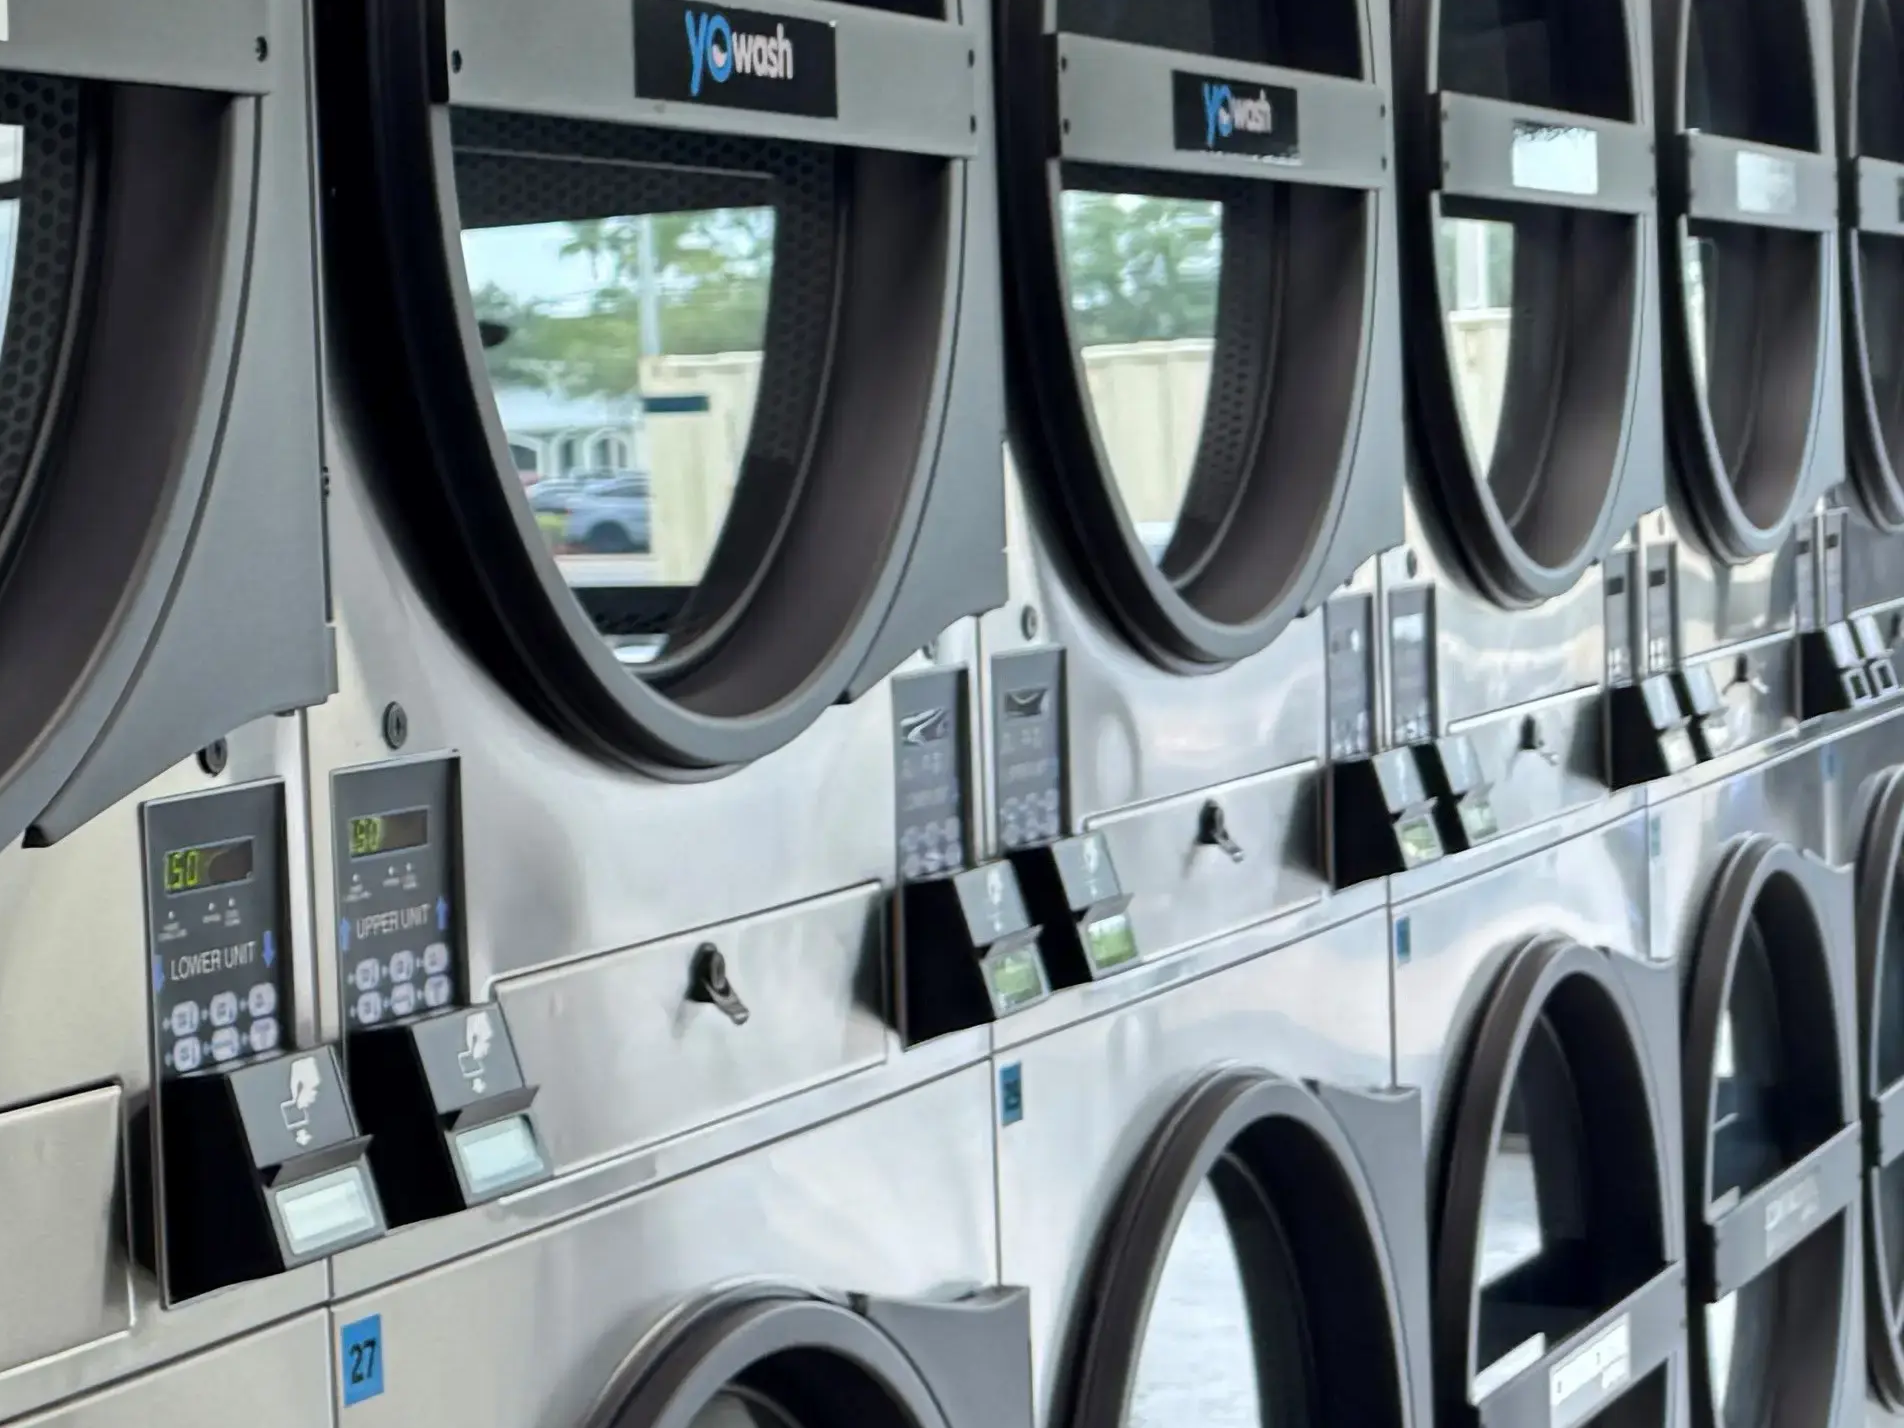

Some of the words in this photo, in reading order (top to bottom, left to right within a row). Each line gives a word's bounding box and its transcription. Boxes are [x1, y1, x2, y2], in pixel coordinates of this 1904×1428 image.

[355, 910, 399, 941] UPPER
[401, 903, 432, 929] UNIT
[170, 950, 222, 981] LOWER
[224, 941, 257, 970] UNIT
[349, 1338, 376, 1385] 27
